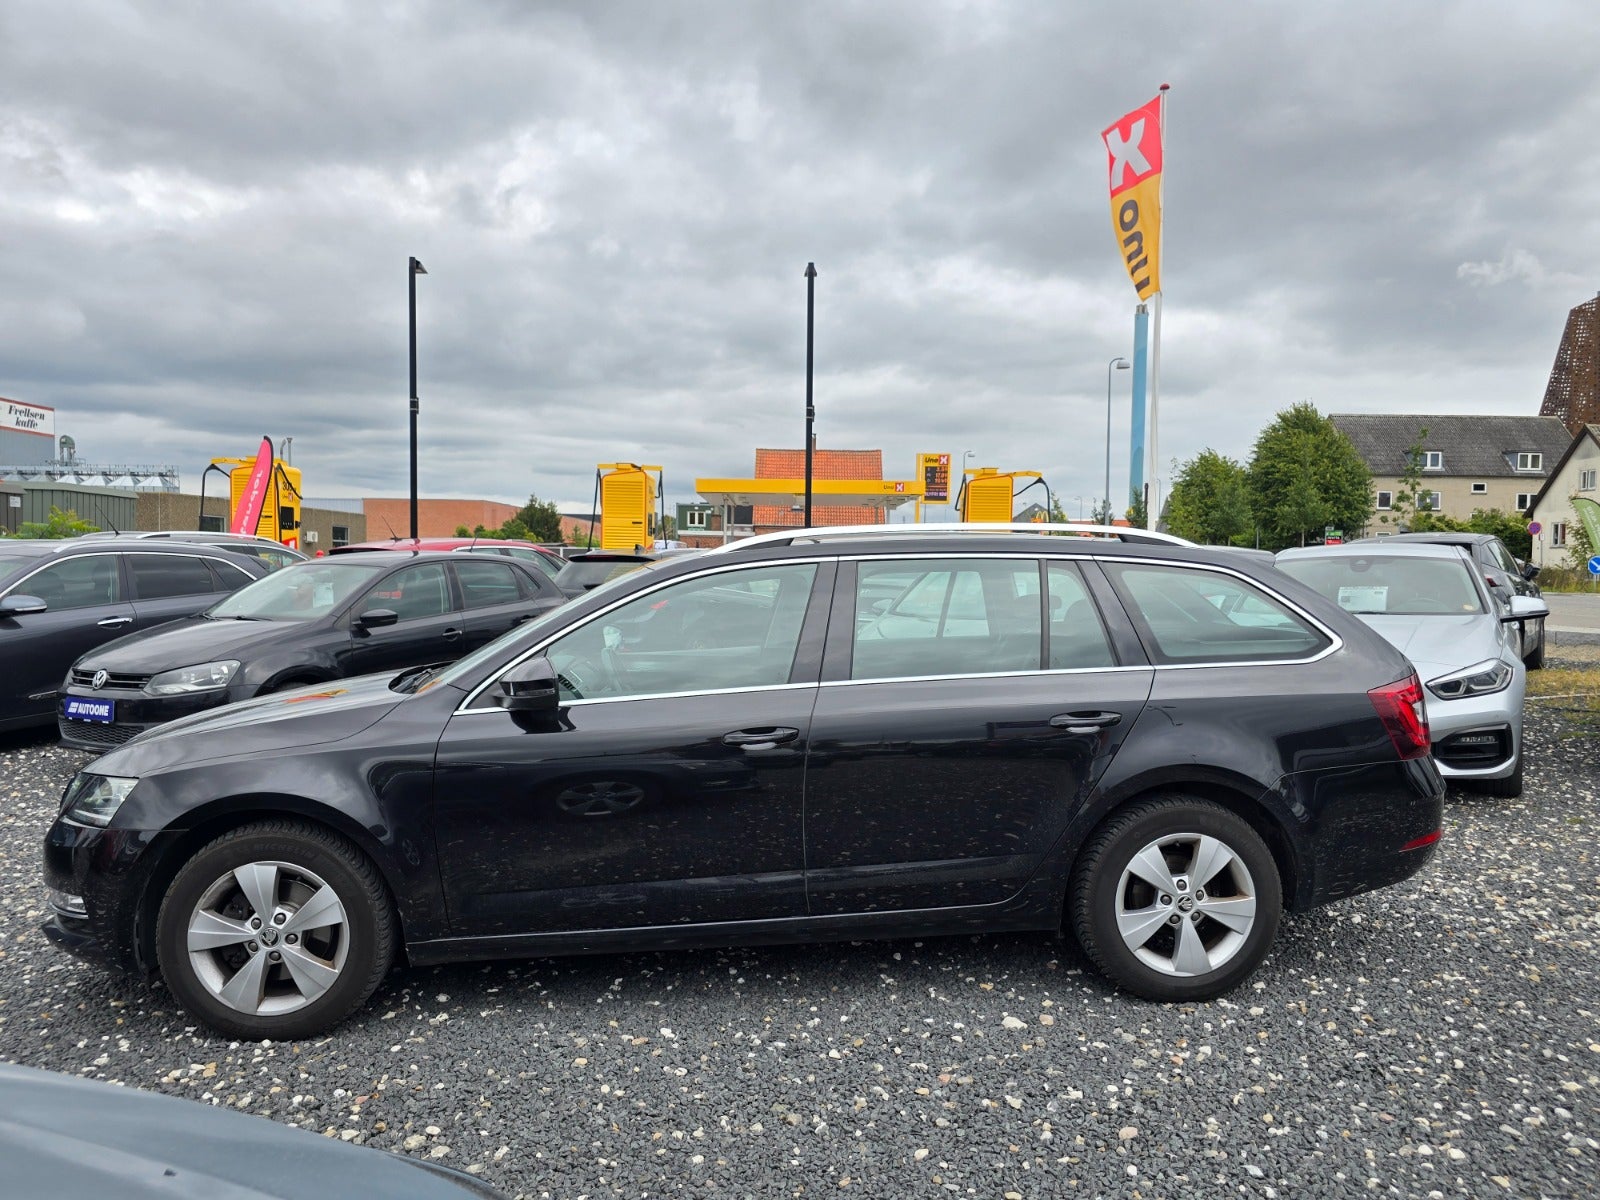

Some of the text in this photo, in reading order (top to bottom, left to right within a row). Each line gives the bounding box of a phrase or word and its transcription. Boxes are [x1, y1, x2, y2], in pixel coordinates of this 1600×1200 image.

[8, 405, 45, 421] Frellsen
[15, 417, 38, 429] kaffe
[77, 703, 110, 716] AUTOONE
